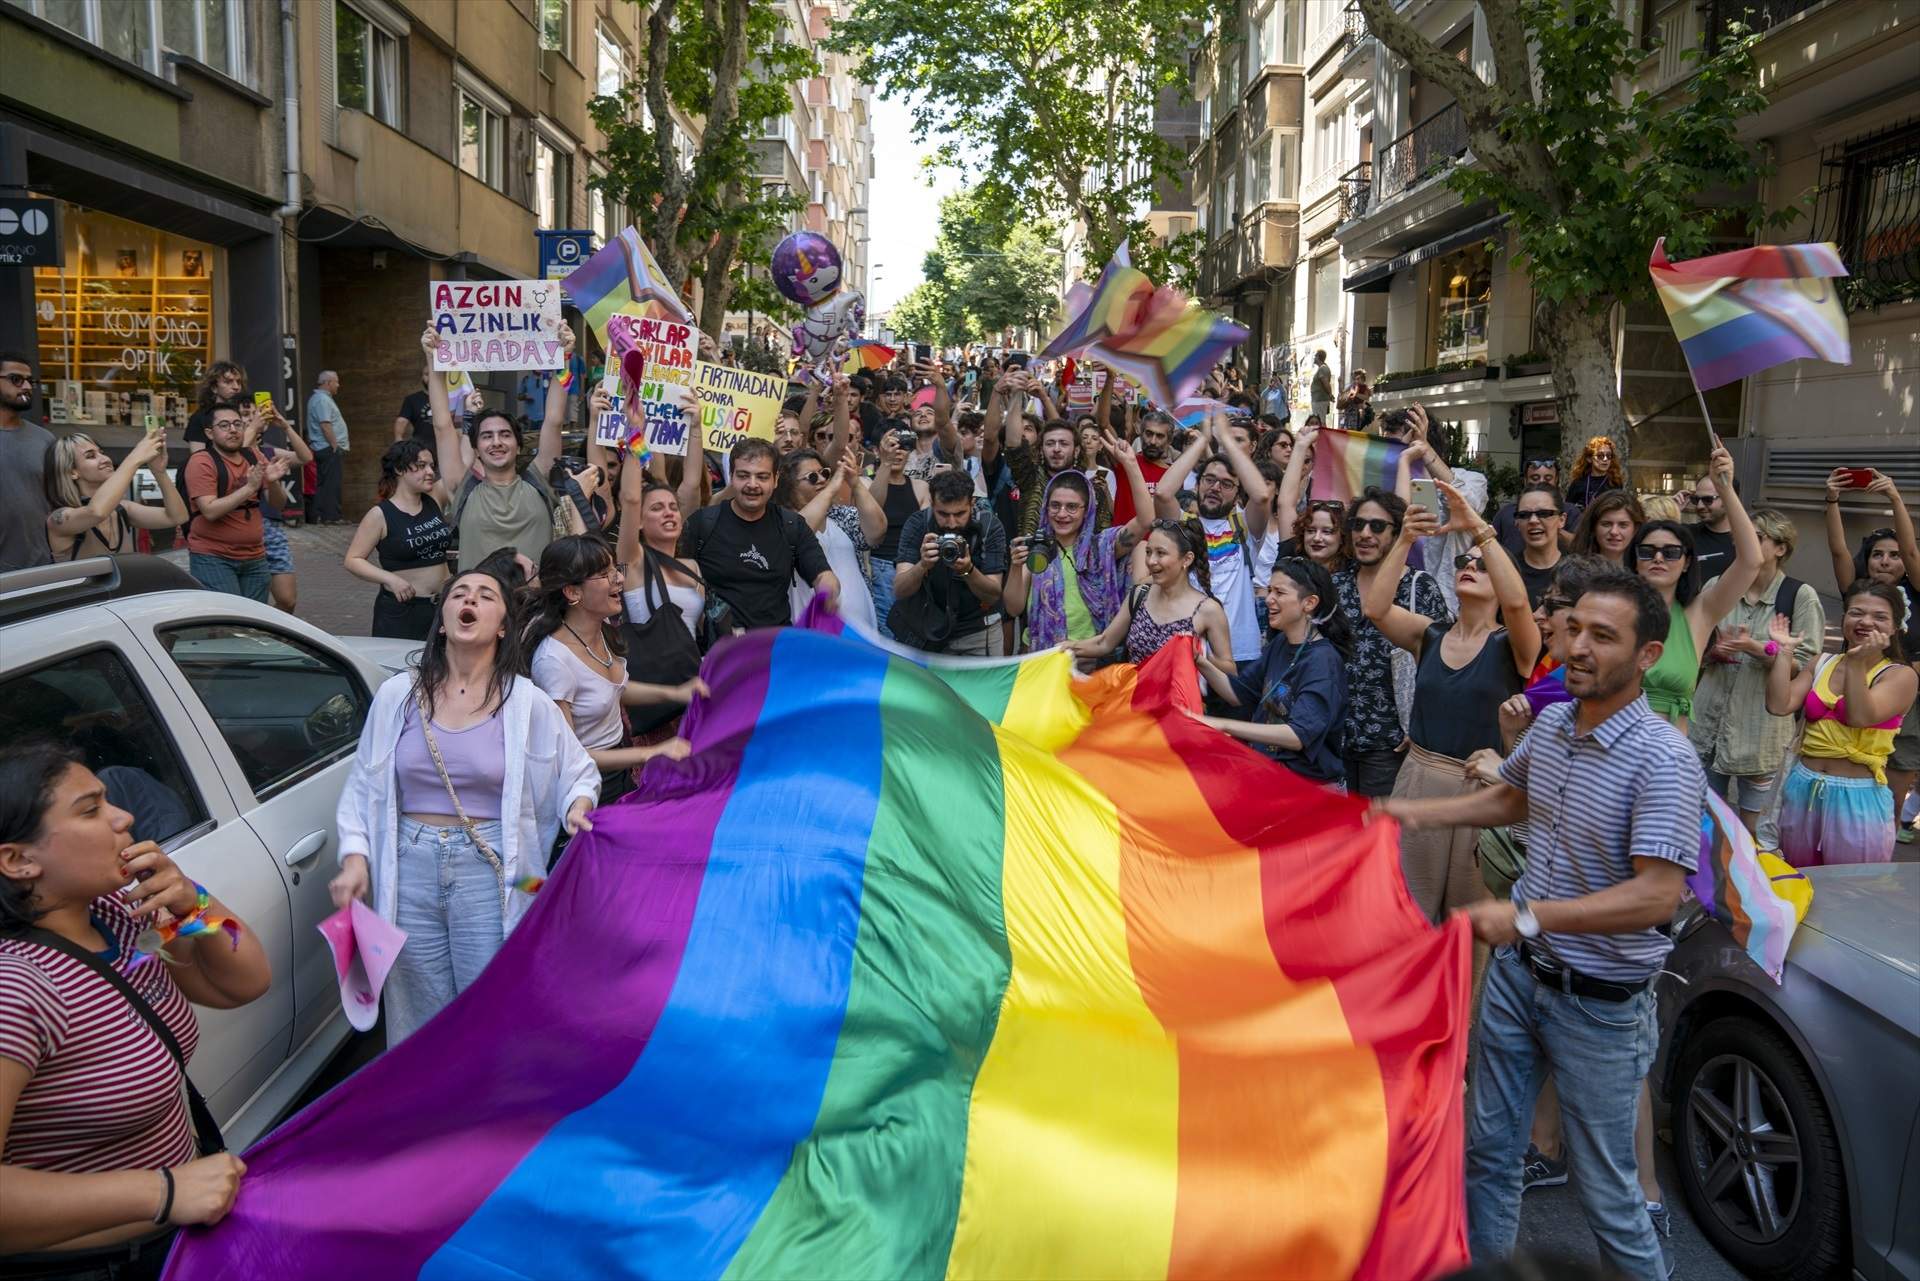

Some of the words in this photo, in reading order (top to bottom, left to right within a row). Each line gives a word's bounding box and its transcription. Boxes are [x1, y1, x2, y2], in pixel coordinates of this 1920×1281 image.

[0, 243, 36, 256] ONO
[16, 254, 23, 263] 2
[435, 284, 522, 310] AZGIN
[103, 306, 202, 348] KOMONO
[435, 312, 542, 335] AZINLIK
[612, 314, 691, 348] ASAKLAR
[122, 348, 172, 375] OPTIK
[194, 359, 202, 376] 2
[695, 386, 735, 407] SONRA
[700, 365, 784, 402] FIRTINADAN
[702, 405, 753, 433] UŞAĞI
[406, 536, 424, 548] TO
